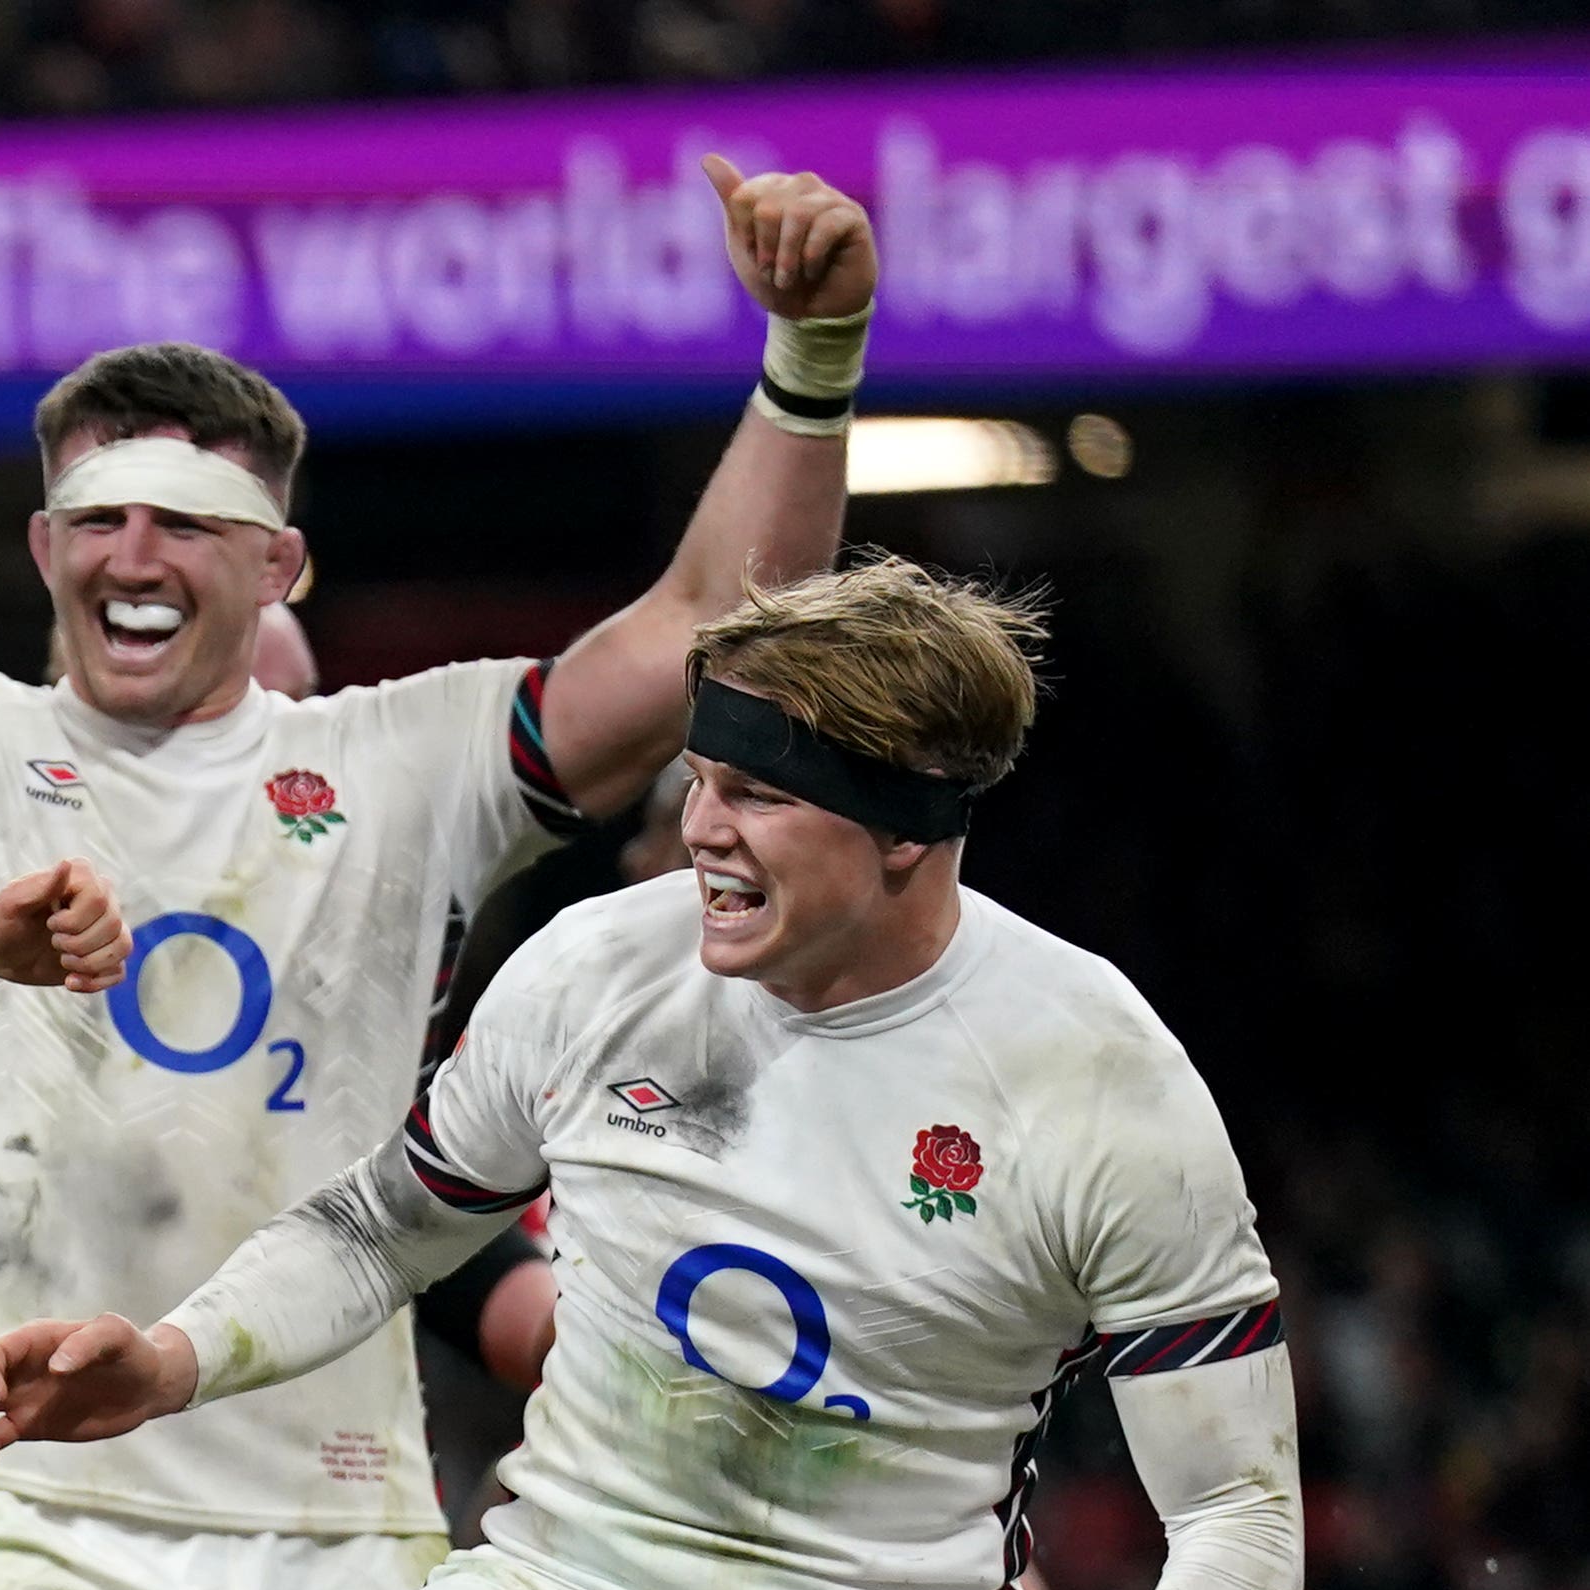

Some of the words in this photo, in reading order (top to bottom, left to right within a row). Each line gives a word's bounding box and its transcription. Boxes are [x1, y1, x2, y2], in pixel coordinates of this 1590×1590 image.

[874, 112, 1464, 355] largest
[25, 785, 83, 811] umbro
[606, 1111, 667, 1139] umbro
